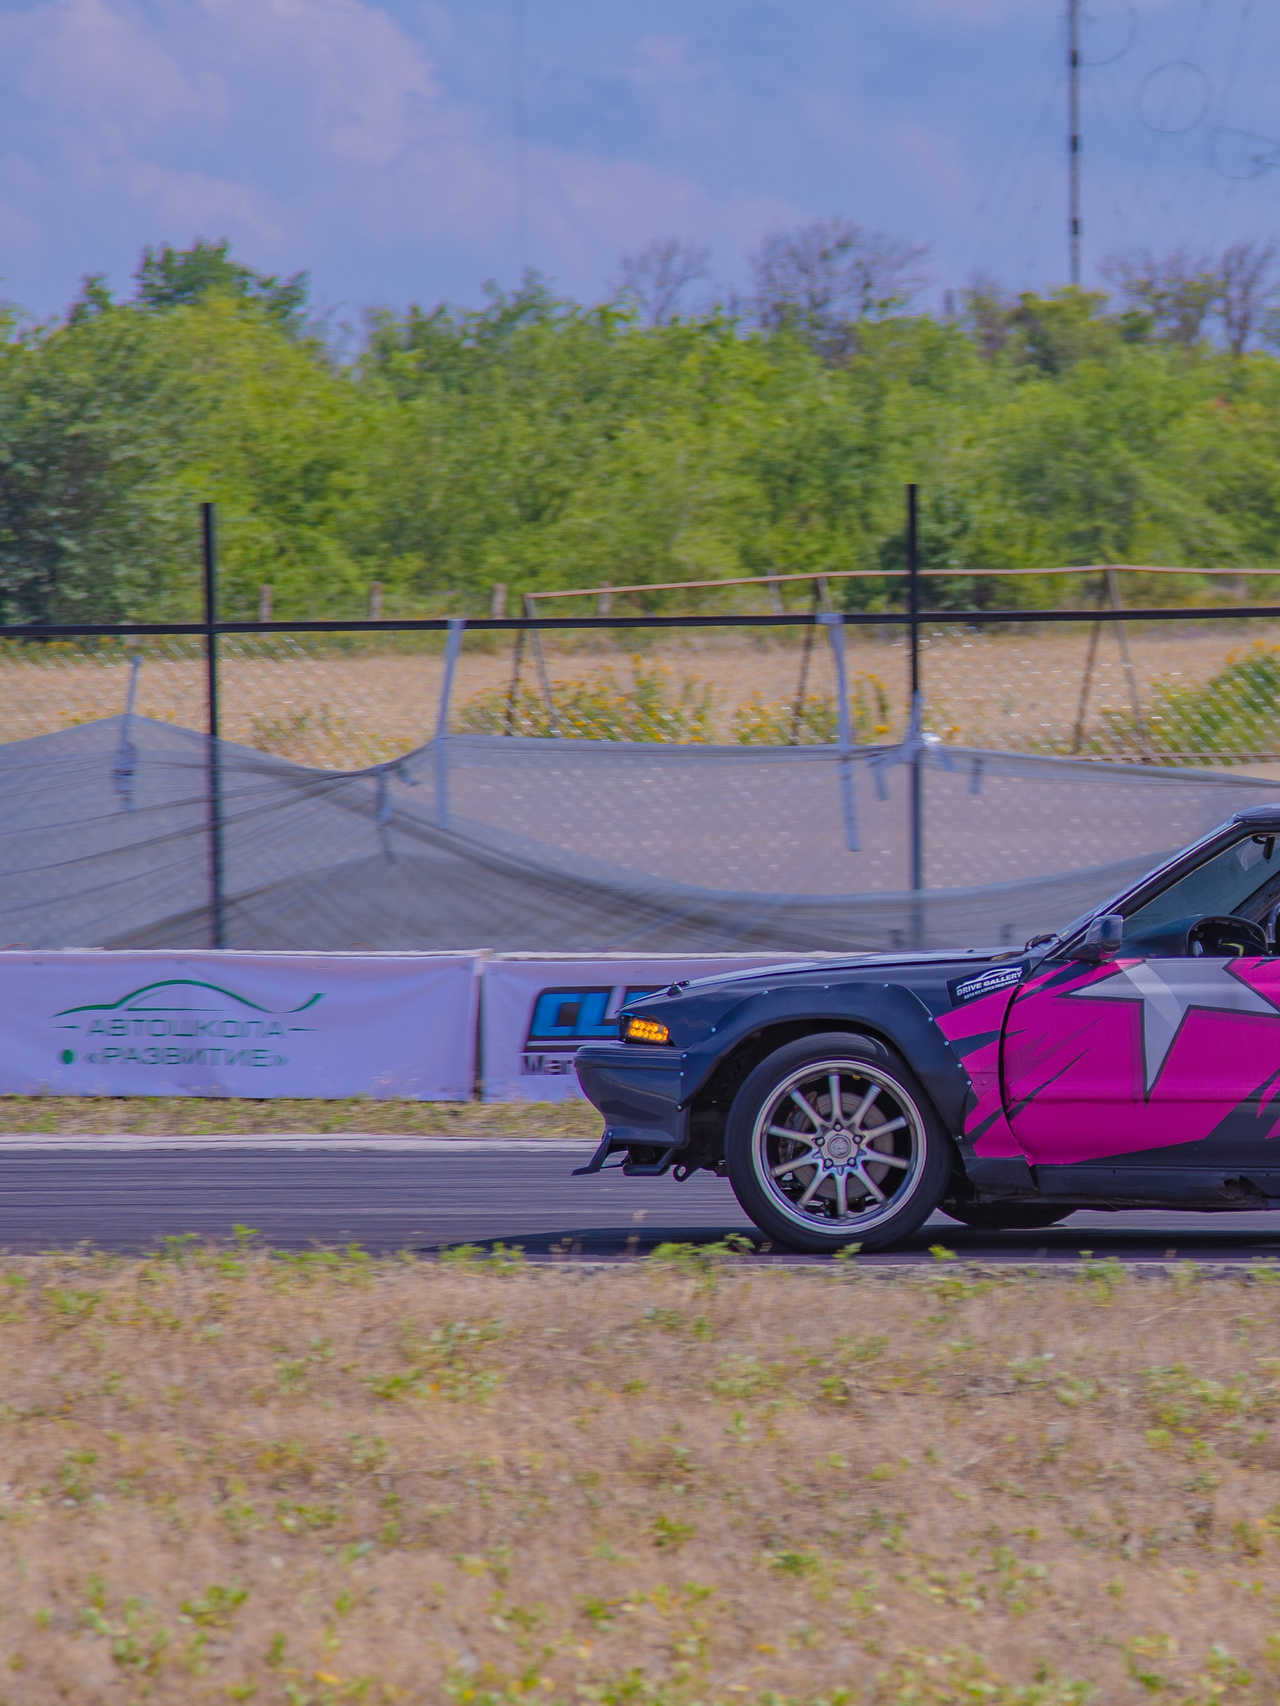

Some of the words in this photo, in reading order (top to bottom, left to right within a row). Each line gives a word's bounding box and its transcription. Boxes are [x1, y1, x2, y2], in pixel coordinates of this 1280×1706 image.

[956, 982, 983, 997] DRIVE
[983, 970, 1023, 987] GALLERY
[85, 1018, 288, 1039] АВТОШКОЛА
[83, 1046, 289, 1068] «РАЗВИТИЕ»
